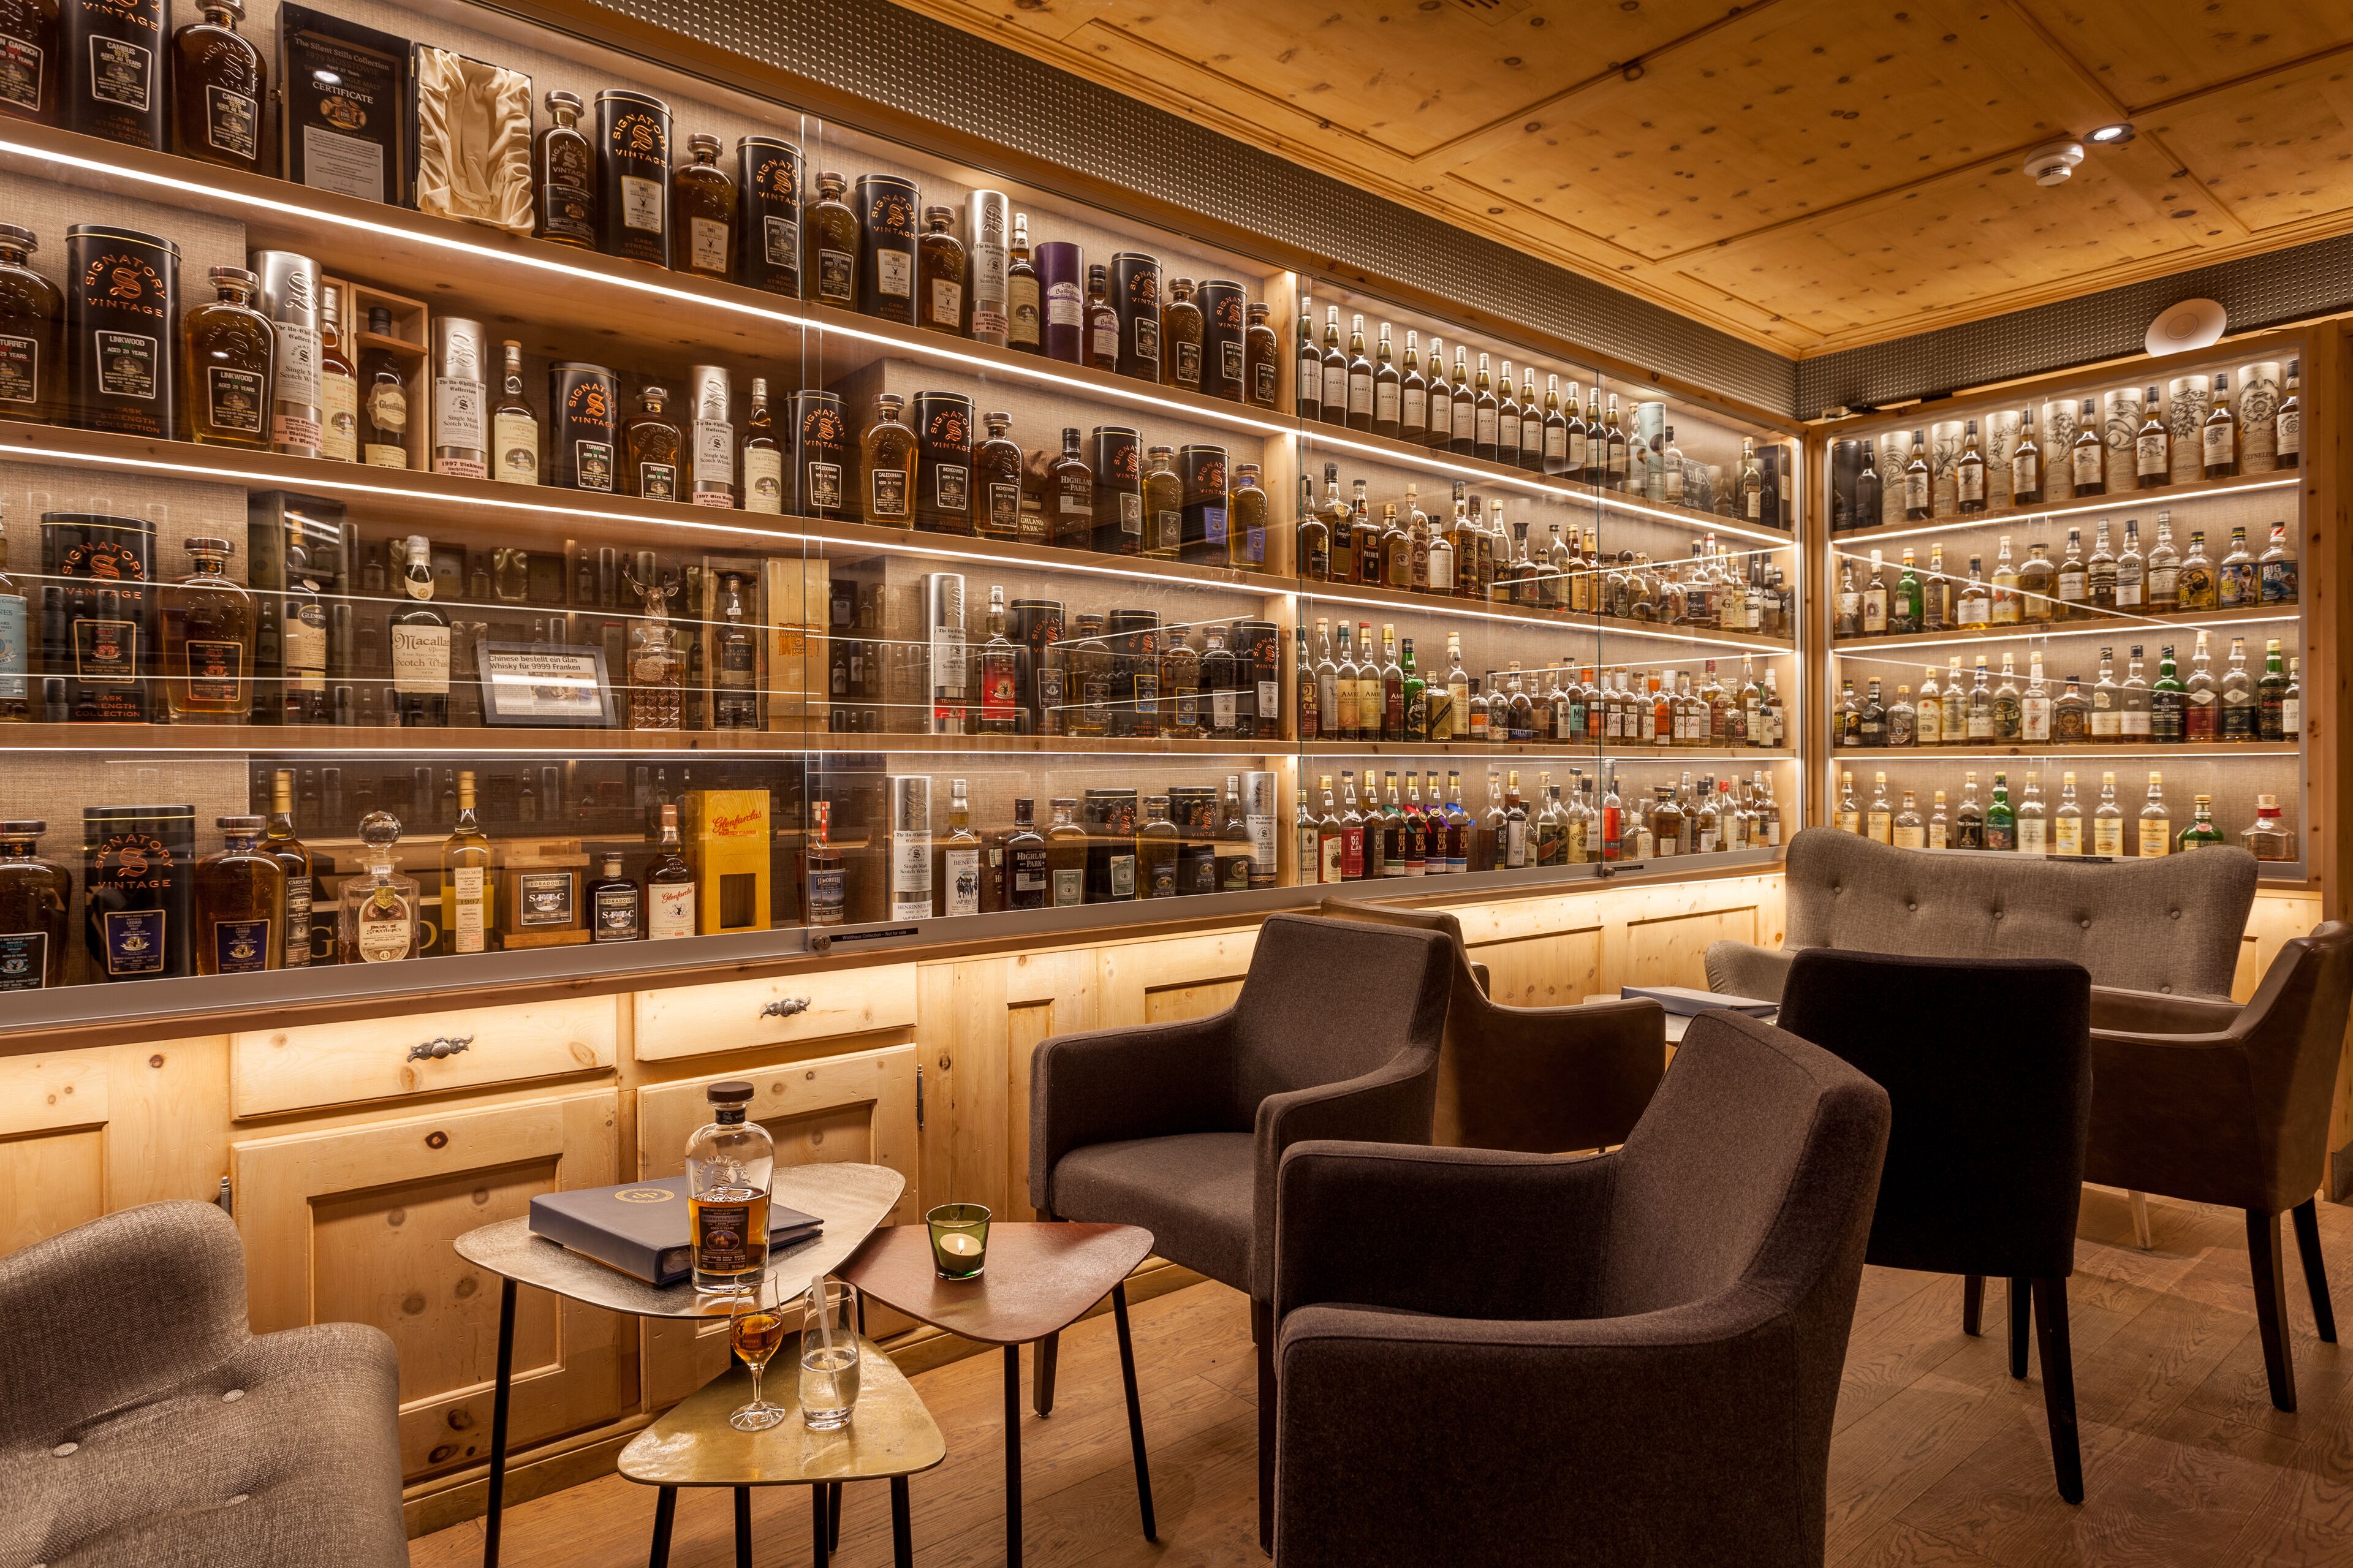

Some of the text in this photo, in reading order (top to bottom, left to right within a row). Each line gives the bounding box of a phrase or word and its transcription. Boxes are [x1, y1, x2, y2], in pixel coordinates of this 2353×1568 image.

[81, 2, 158, 32] VINTAGE
[107, 42, 136, 55] CAMBUS
[295, 37, 390, 70] The Silent Stills Collection
[100, 52, 142, 69] AGED YEARS
[313, 81, 373, 104] CERTIFICATE
[222, 93, 246, 107] CAMBUS
[109, 114, 137, 126] CASK
[94, 119, 150, 138] STRENGTH
[613, 113, 667, 154] SIGNATORY
[89, 127, 154, 148] COLLECTION
[615, 148, 666, 169] VINTAGE
[552, 166, 586, 180] VINTAGE
[872, 195, 917, 227] SIGNATORY
[873, 225, 915, 240] VINTAGE
[621, 249, 664, 261] COLLECTION
[624, 243, 661, 254] STRENGTH
[86, 254, 167, 300] SIGNATORY
[88, 298, 164, 318] VINTAGE
[109, 336, 145, 346] LINKWOOD
[221, 371, 253, 382] LINKWOOD
[115, 406, 142, 415] CASK
[100, 412, 156, 425] STRENGTH
[571, 416, 618, 430] VINTAGE
[804, 409, 845, 438] SIGNATORY
[931, 411, 972, 439] SIGNATORY
[96, 420, 160, 434] COLLECTION
[804, 439, 844, 451] VINTAGE
[932, 442, 971, 453] VINTAGE
[1061, 475, 1093, 486] HIGHLAND
[62, 541, 144, 581] SIGNATORY
[2222, 579, 2235, 589] BIG
[66, 588, 142, 599] VINTAGE
[396, 657, 425, 667] Scotch
[490, 662, 518, 670] Whisky
[713, 809, 761, 833] Glenfarclas
[94, 834, 174, 869] SIGNATORY
[97, 879, 172, 890] VINTAGE
[311, 926, 336, 958] G
[695, 1154, 751, 1186] SIGNATORY
